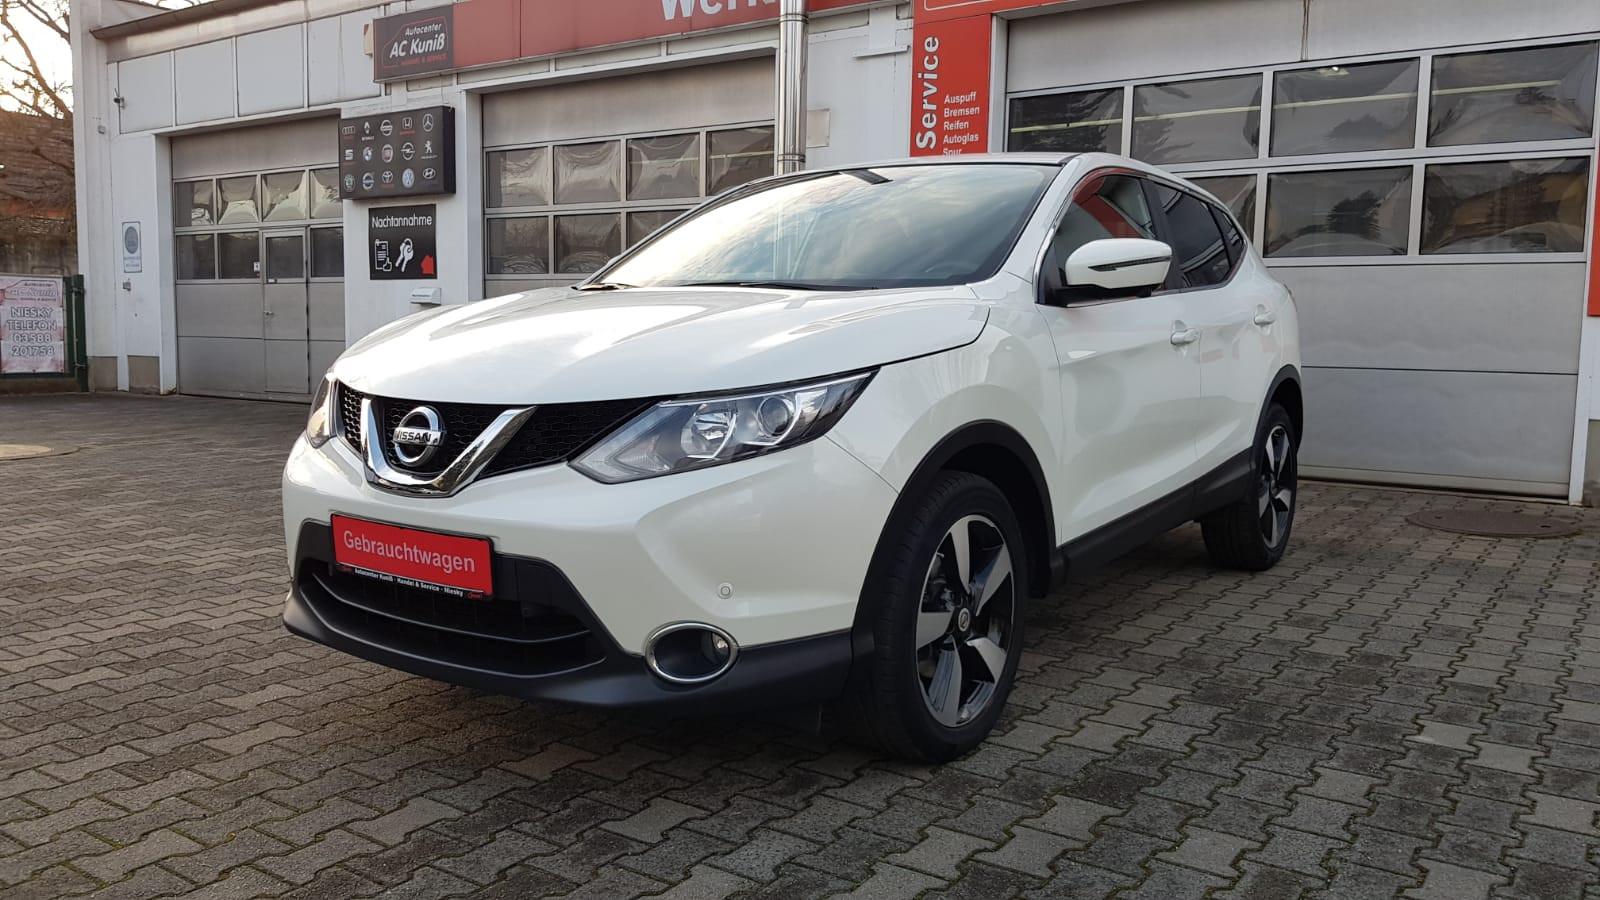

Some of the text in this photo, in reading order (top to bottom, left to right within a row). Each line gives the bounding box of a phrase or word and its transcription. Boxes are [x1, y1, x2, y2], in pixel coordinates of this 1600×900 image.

[405, 23, 442, 36] Autocenter
[389, 33, 446, 59] AC Kuniß
[916, 36, 940, 150] Service
[944, 92, 976, 105] Auspuff
[944, 106, 980, 118] Bremsen
[943, 121, 969, 131] Reifen
[943, 133, 979, 145] Autoglas
[371, 212, 432, 229] Nachtannahme
[11, 306, 54, 318] NIESKY
[7, 320, 57, 331] TELEFON
[13, 332, 52, 343] 03588
[395, 431, 432, 443] NISSAN
[343, 530, 476, 574] Gebrauchtwagen
